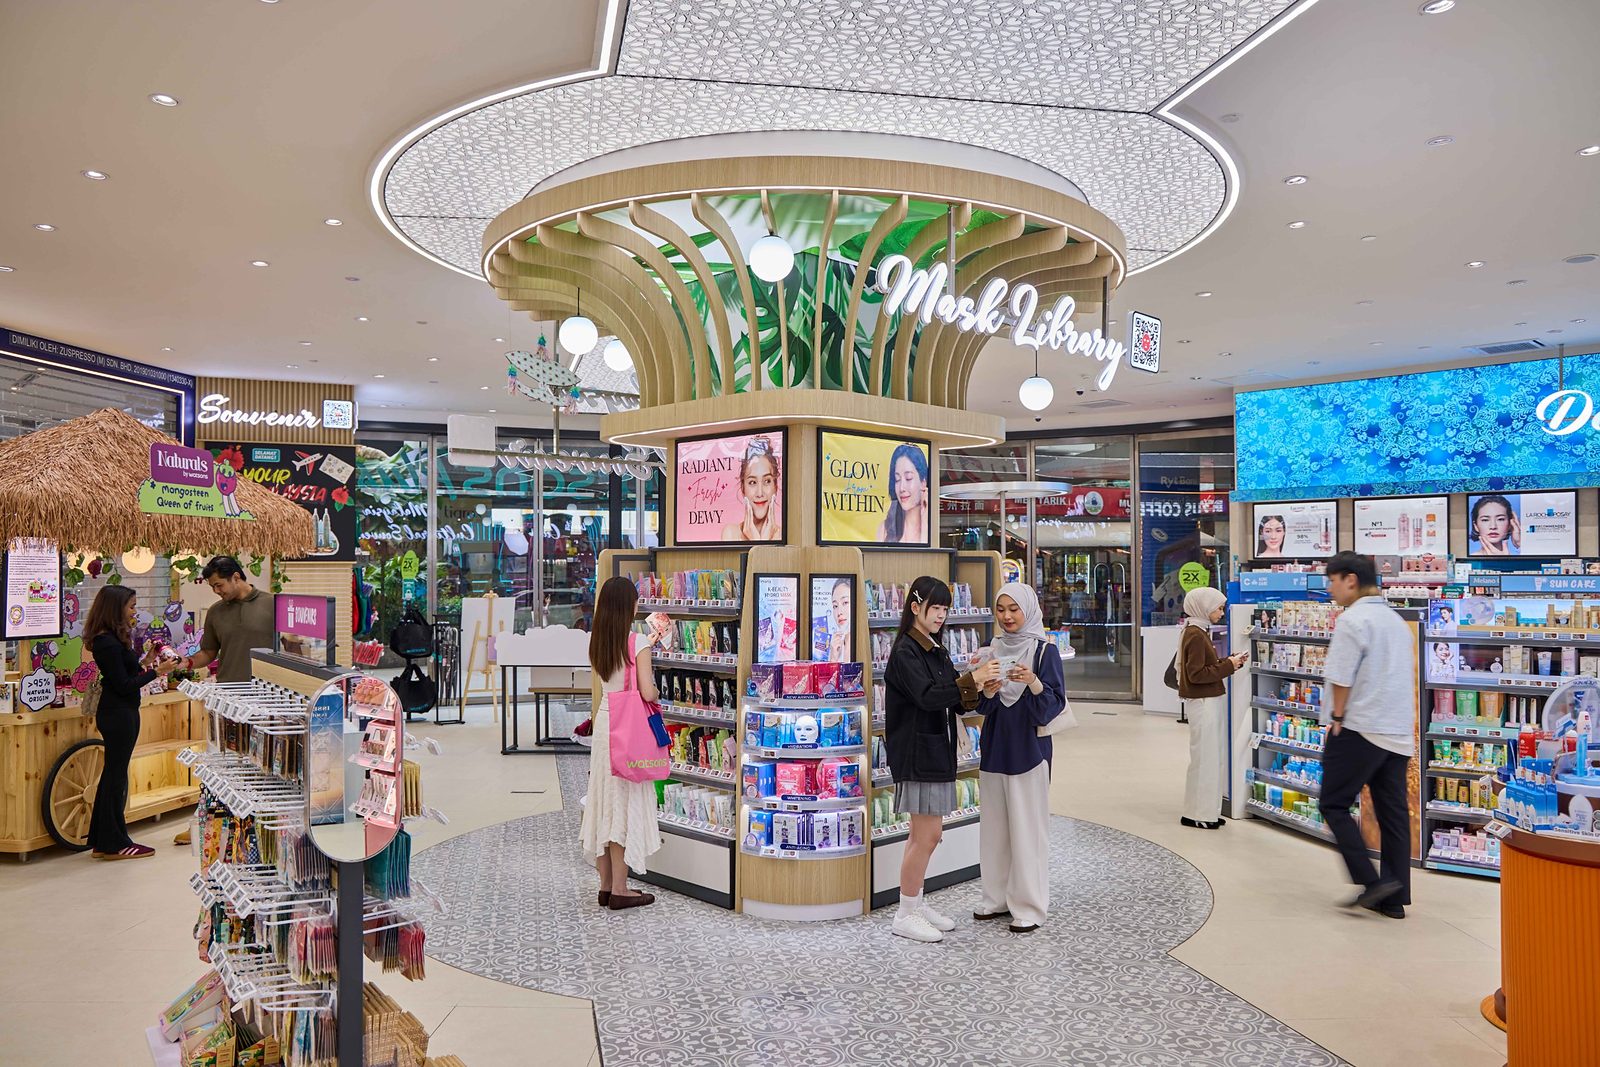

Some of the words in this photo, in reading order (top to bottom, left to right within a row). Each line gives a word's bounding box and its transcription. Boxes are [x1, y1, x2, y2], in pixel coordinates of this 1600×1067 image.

[875, 253, 1009, 335] Mask
[1008, 282, 1128, 391] Library
[12, 334, 38, 349] DIMILIKI
[39, 341, 58, 354] OLEH:
[59, 346, 96, 363] ZUSPRESSO
[96, 356, 106, 367] (M)
[106, 358, 119, 369] SDN.
[197, 393, 322, 429] Souvenir
[157, 449, 208, 472] Naturals
[681, 457, 735, 475] RADIANT
[243, 467, 291, 485] YOUR
[830, 459, 880, 480] GLOW
[162, 485, 209, 498] Mangosteen
[691, 477, 725, 508] Fresh
[844, 473, 869, 495] from
[157, 496, 182, 508] Queen
[183, 500, 193, 509] of
[195, 501, 214, 512] fruits
[823, 492, 885, 513] WITHIN
[1039, 497, 1067, 506] TARIK
[688, 510, 724, 525] DEWY
[403, 560, 413, 569] 2X
[1182, 572, 1200, 582] 2X
[1549, 579, 1569, 588] SUN
[1570, 579, 1597, 588] CARE
[27, 688, 52, 696] NATURAL
[28, 695, 50, 703] ORIGIN
[626, 758, 668, 769] watsons
